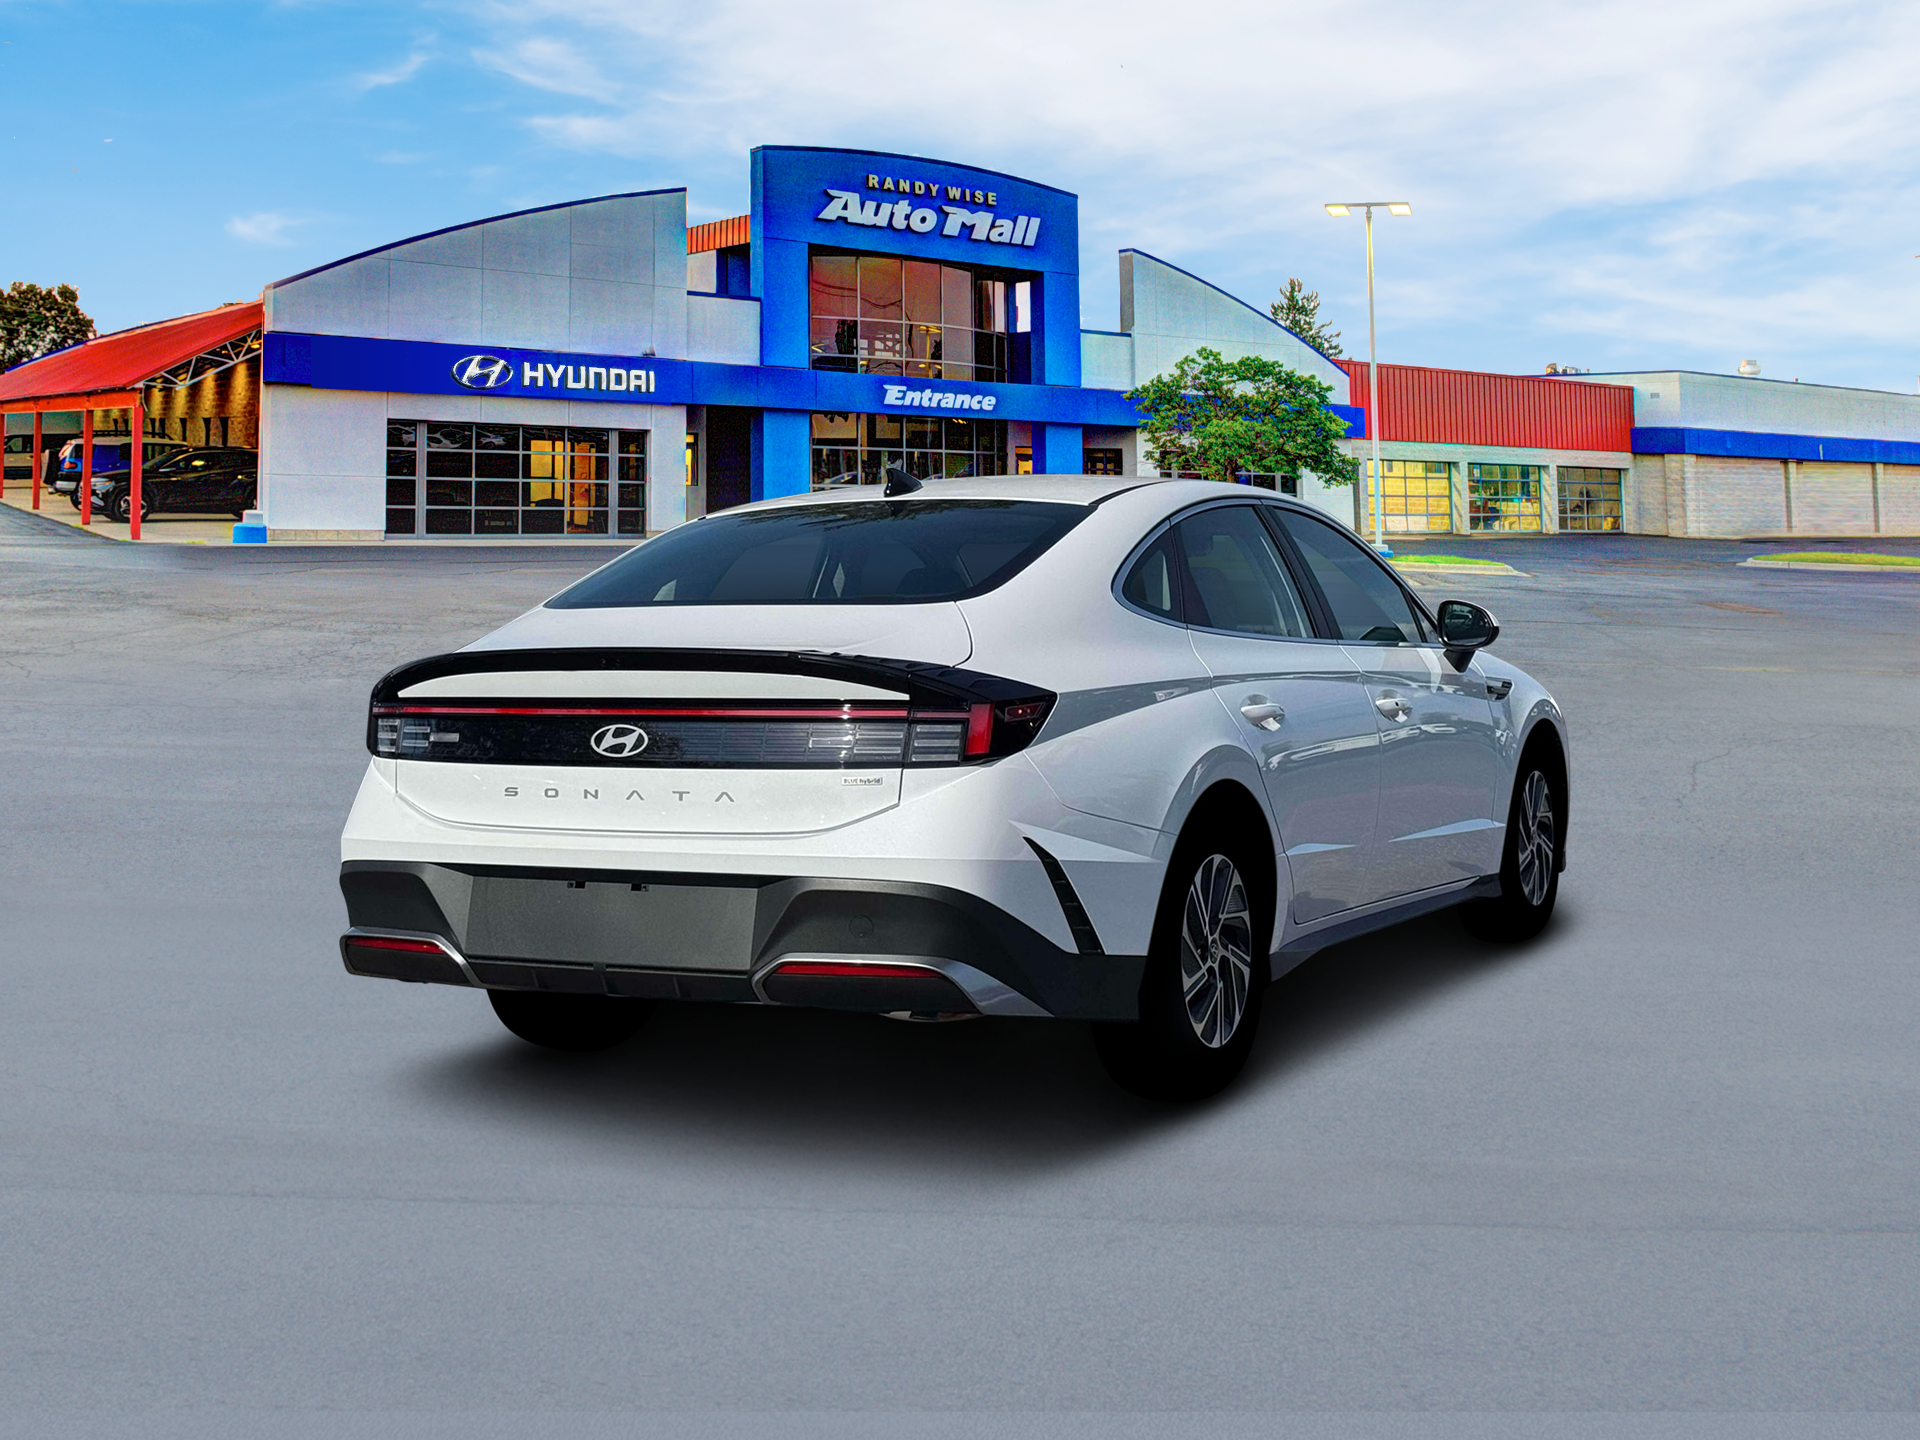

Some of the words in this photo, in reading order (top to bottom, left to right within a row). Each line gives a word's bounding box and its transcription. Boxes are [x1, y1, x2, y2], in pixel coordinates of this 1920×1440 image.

[866, 174, 939, 197] RANDY
[946, 185, 997, 205] WISE
[816, 188, 938, 233] Auto
[941, 205, 1041, 246] Mall
[522, 362, 656, 393] HYUNDAI
[883, 384, 997, 411] Entrance
[504, 786, 735, 803] SONATA
